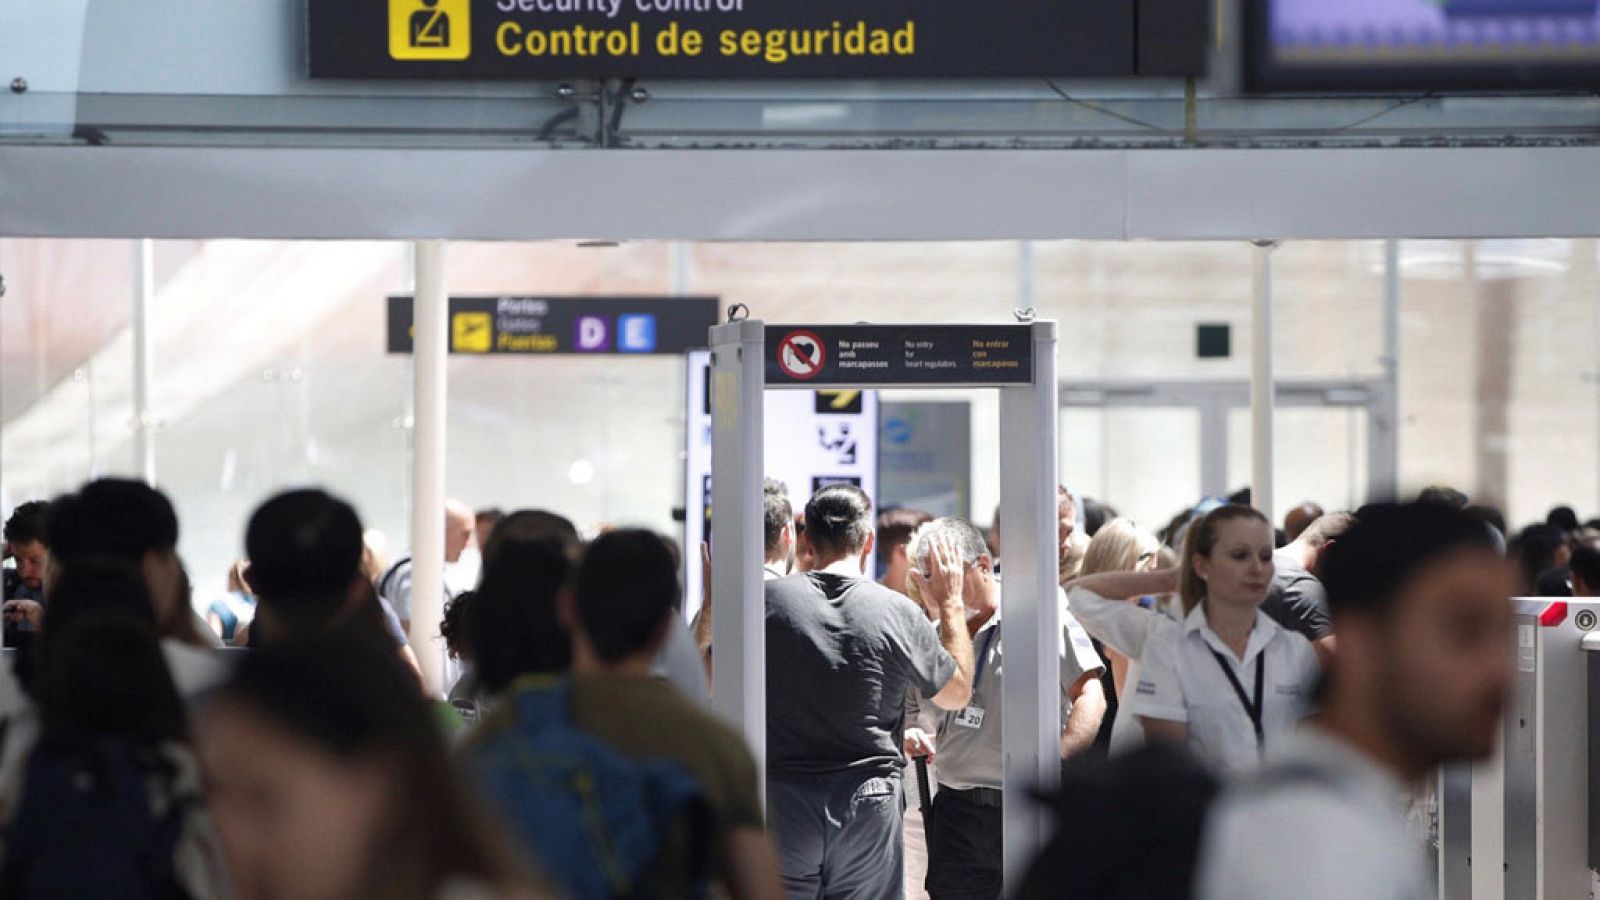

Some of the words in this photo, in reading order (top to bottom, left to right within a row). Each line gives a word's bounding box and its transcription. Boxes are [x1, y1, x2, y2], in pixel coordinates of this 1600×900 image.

[496, 21, 639, 56] Control
[656, 21, 702, 56] de
[719, 21, 915, 62] seguridad
[579, 316, 605, 348] D
[624, 316, 649, 348] E
[838, 340, 850, 349] No
[851, 341, 879, 351] passeu
[904, 340, 914, 349] No
[916, 340, 934, 351] entry
[972, 340, 984, 348] No
[985, 340, 1009, 348] entrar
[838, 350, 857, 359] amb
[972, 351, 987, 359] con
[838, 360, 889, 370] marcapassos
[968, 715, 980, 726] 20
